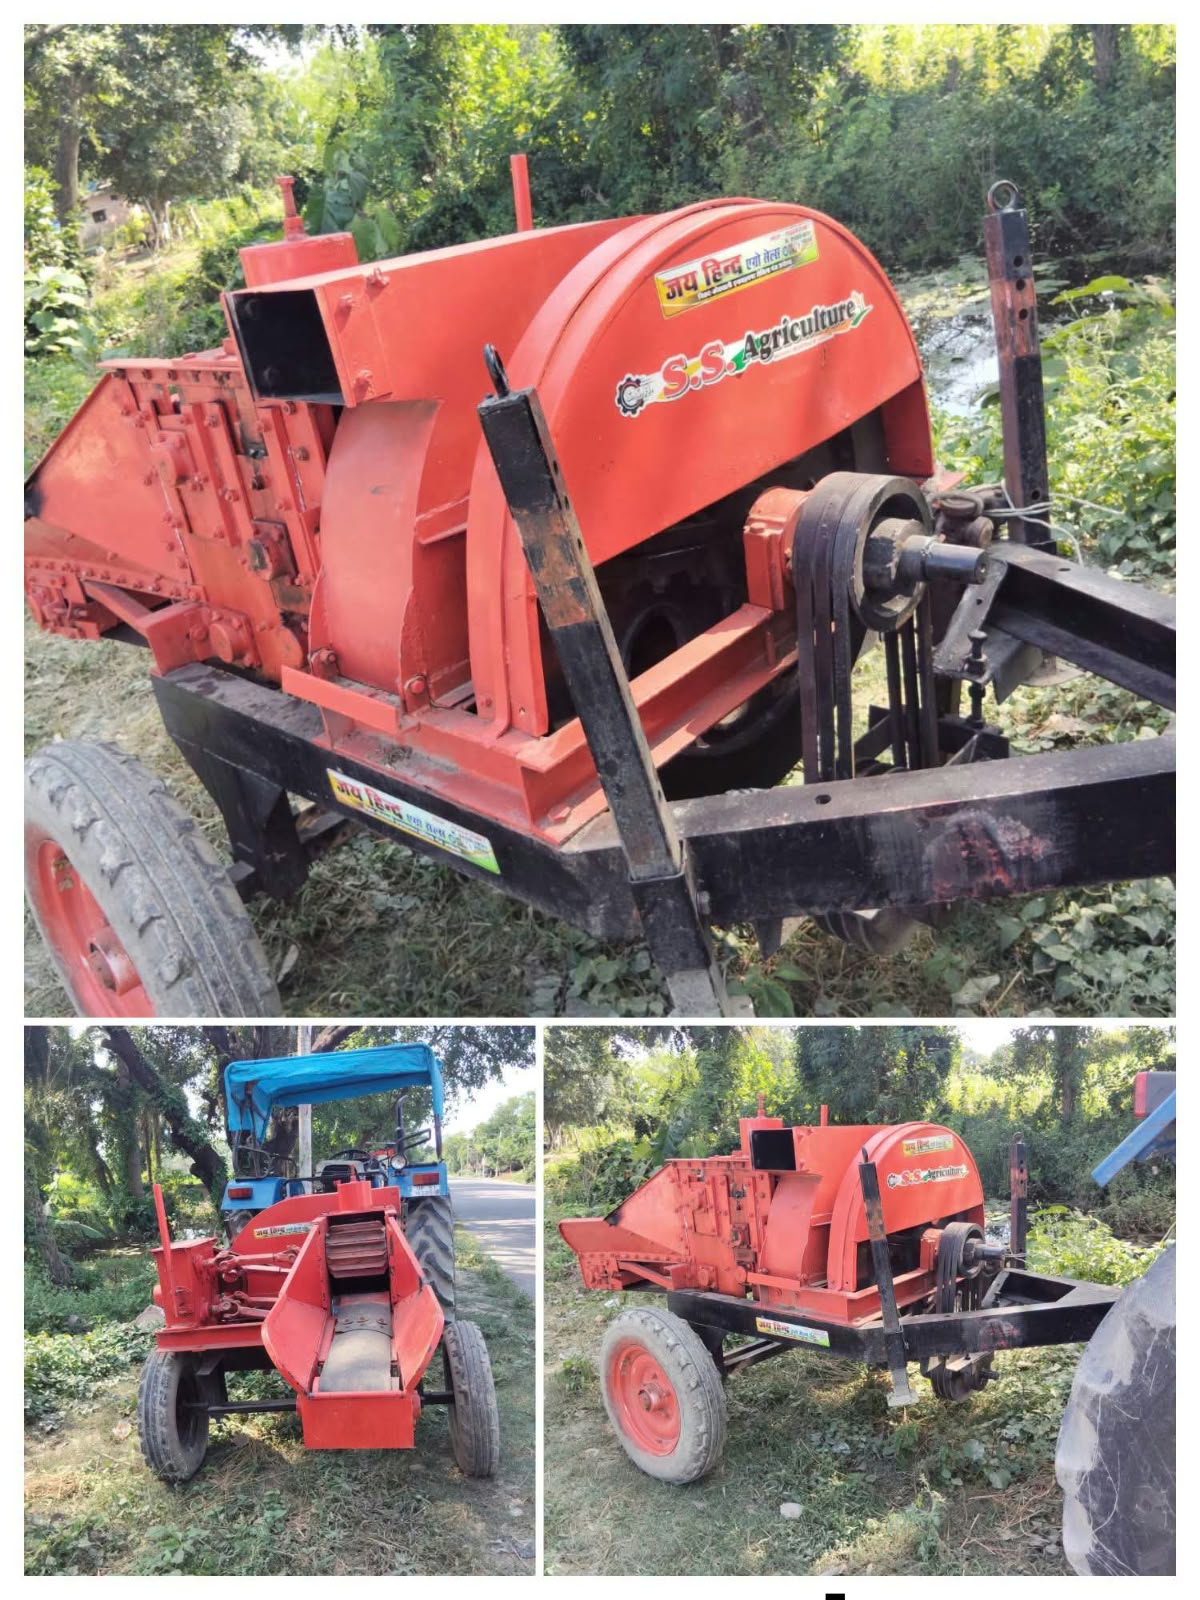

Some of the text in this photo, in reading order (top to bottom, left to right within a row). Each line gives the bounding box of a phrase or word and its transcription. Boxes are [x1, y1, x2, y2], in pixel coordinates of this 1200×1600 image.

[663, 270, 698, 300] जय
[701, 258, 742, 286] हिन्द
[662, 298, 856, 400] S.S. Agriculture
